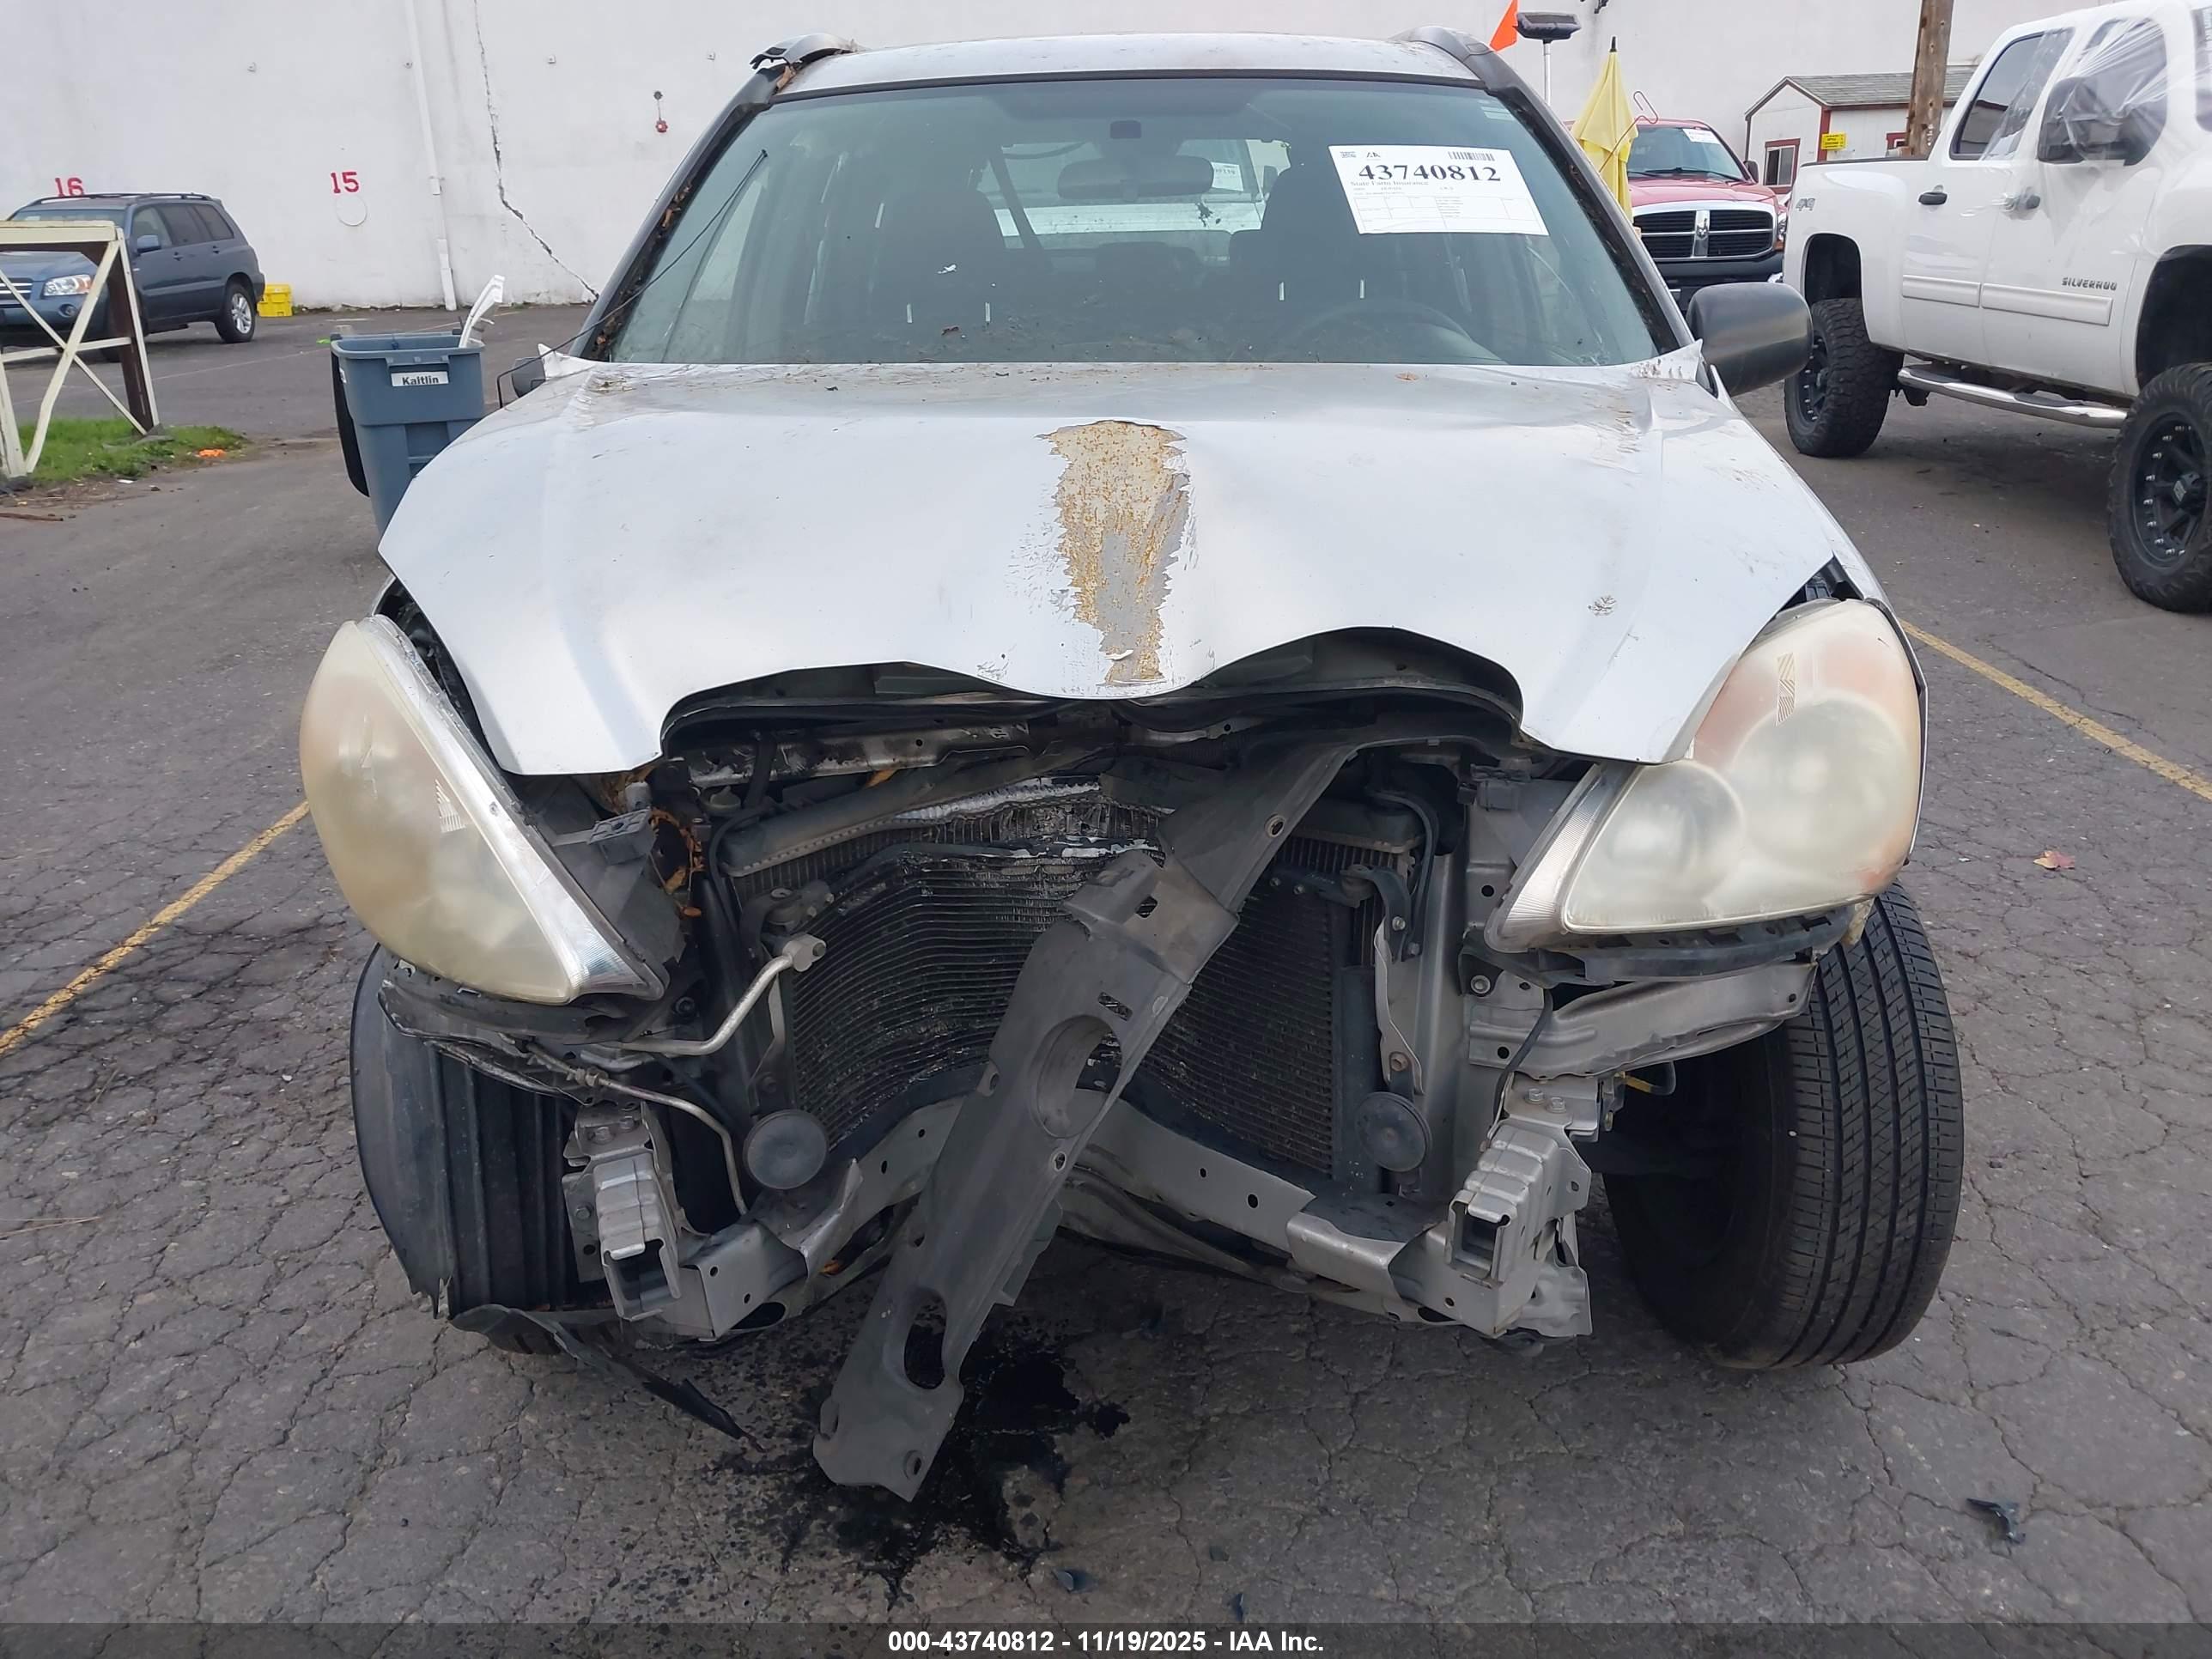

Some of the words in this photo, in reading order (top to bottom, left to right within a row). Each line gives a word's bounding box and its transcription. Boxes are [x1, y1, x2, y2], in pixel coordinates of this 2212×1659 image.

[1358, 164, 1501, 182] 43740812
[55, 177, 84, 198] 16
[331, 172, 360, 194] 15
[2061, 276, 2118, 291] SILVERADO
[402, 375, 440, 386] Kaitlin
